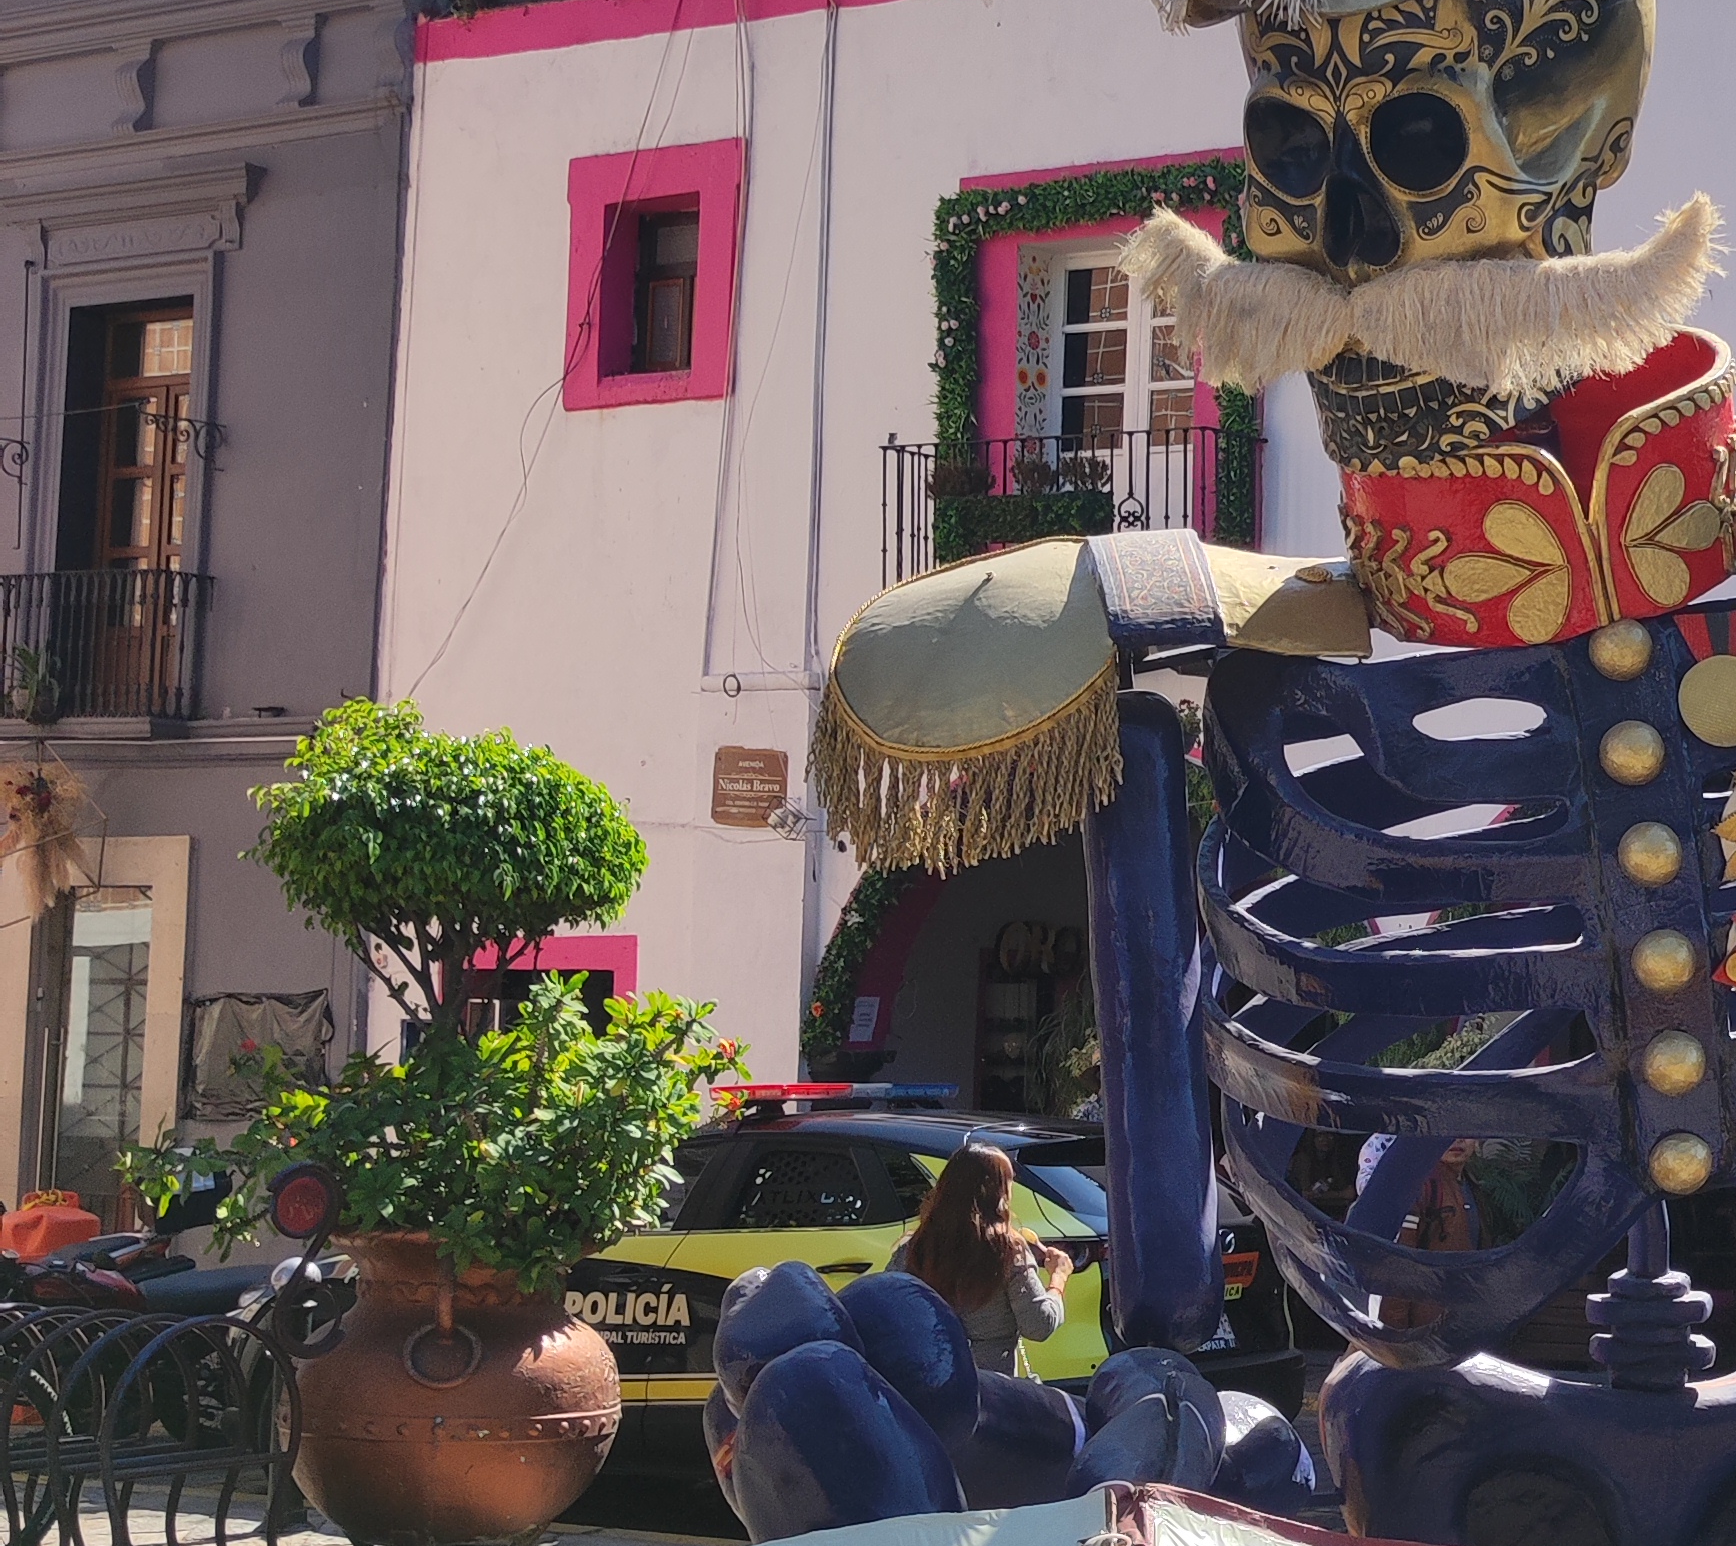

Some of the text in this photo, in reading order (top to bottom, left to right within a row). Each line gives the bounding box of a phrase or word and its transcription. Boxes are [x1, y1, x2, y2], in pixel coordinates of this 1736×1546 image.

[718, 778, 780, 792] Nicolás Bravo
[565, 1284, 691, 1326] POLICÍA
[626, 1329, 686, 1344] TURÍSTICA
